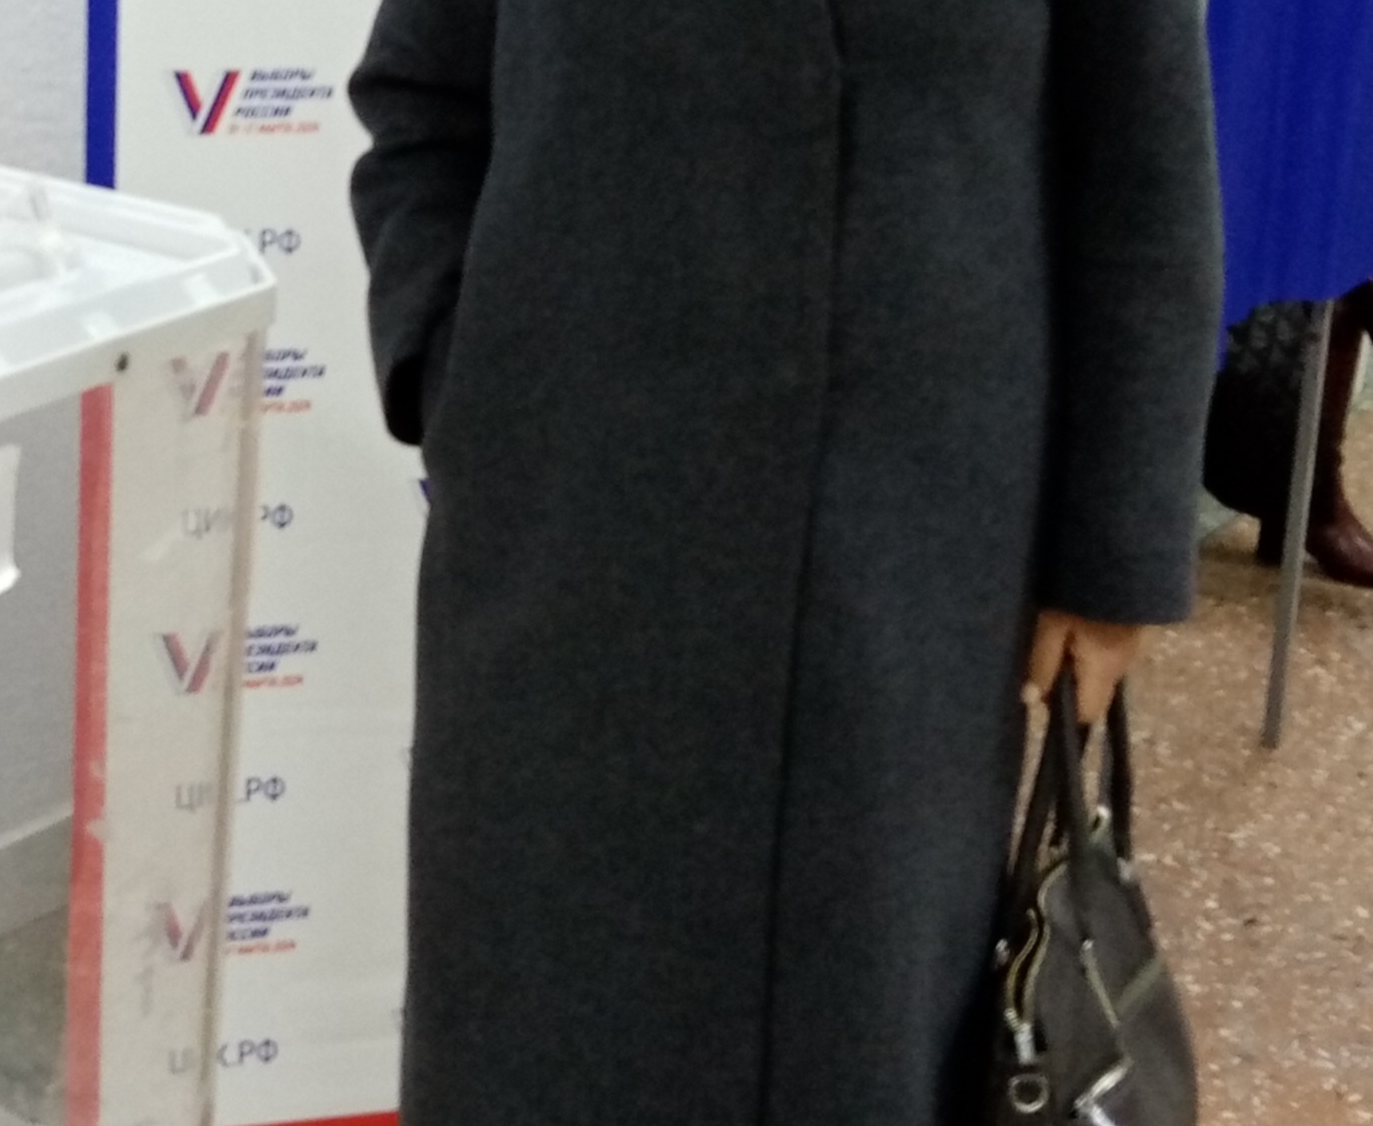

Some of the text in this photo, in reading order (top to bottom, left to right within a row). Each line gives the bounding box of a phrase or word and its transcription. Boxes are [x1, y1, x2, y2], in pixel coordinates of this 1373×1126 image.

[250, 68, 316, 82] ВЫБОРЫ
[242, 85, 335, 101] ПРЕЗИДЕНТА
[234, 105, 293, 119] РОССИИ
[263, 365, 326, 380] ЗИДЕНТА
[245, 640, 319, 657] ЕЗИДЕНТА
[227, 906, 311, 923] РЕЗИДЕНТА
